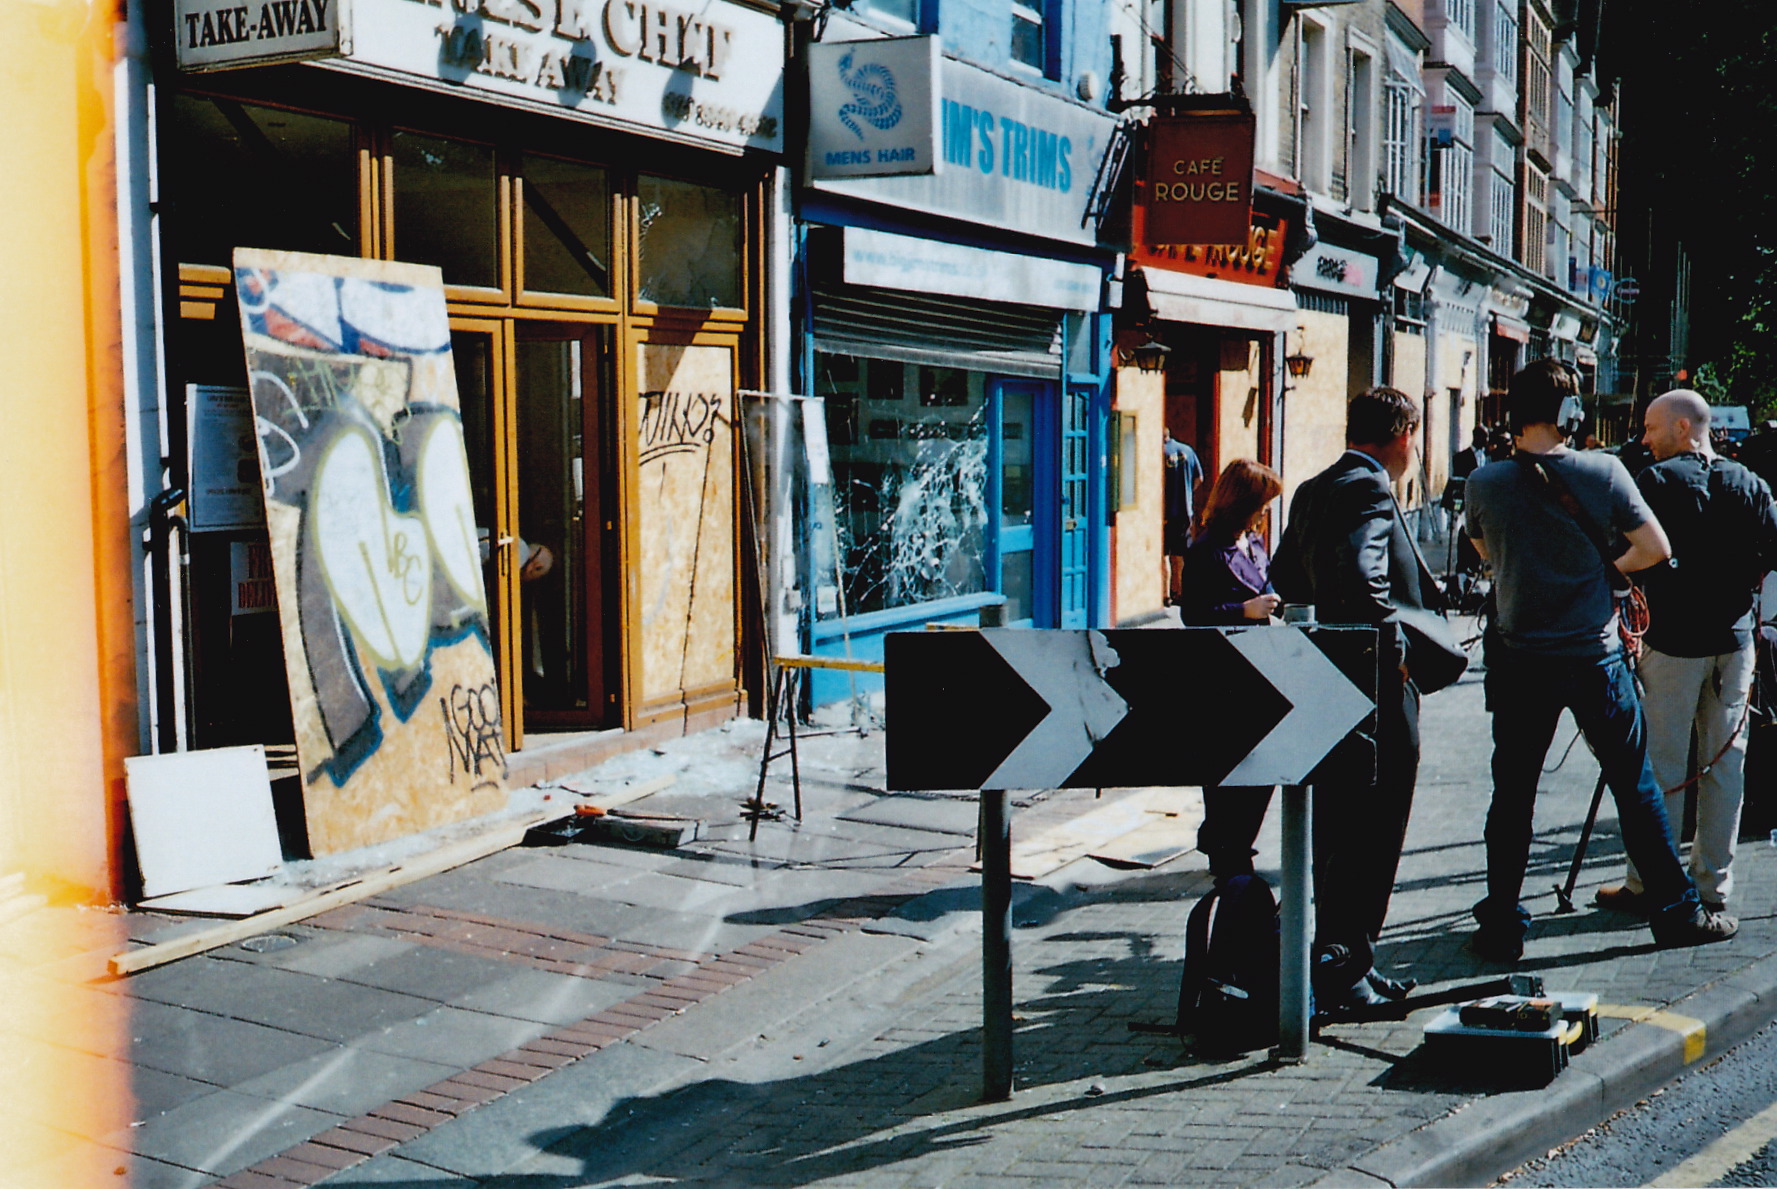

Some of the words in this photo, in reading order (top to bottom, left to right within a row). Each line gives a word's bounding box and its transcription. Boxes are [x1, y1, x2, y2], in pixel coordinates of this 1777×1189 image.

[185, 0, 328, 49] TAKE-AWAY
[825, 149, 872, 166] MENS
[877, 147, 916, 163] HAIR
[1000, 116, 1072, 194] TRIMS
[1155, 182, 1240, 202] ROUGE
